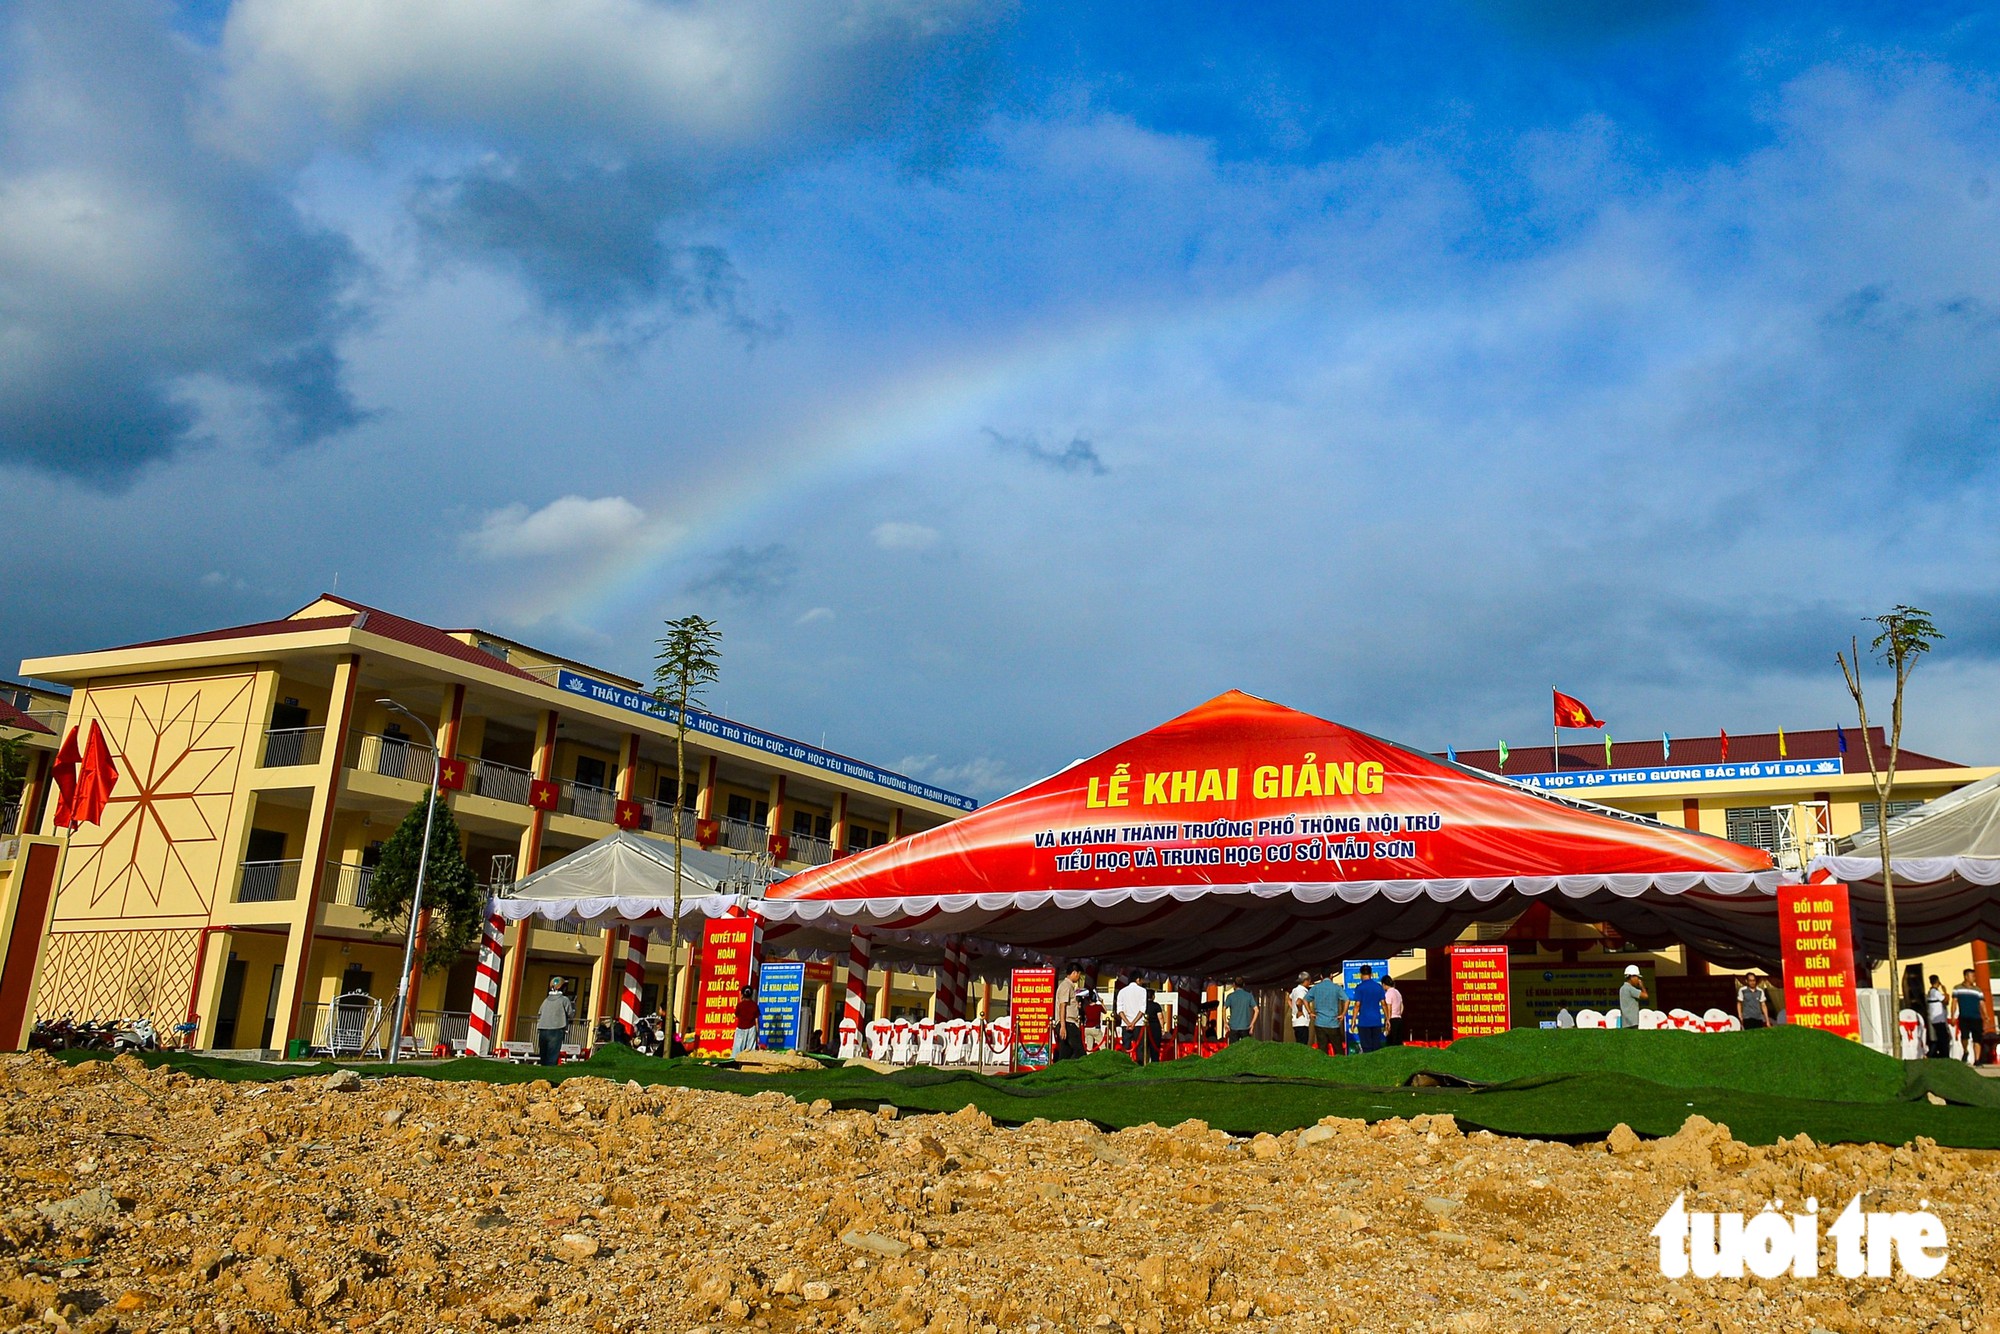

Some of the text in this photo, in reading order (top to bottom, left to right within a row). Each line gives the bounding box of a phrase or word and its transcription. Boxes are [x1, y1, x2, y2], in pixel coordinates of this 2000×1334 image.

[624, 696, 639, 708] CÔ
[698, 719, 719, 733] HỌC
[743, 731, 763, 747] TÍCH
[807, 752, 825, 765] HỌC
[826, 758, 841, 770] YÊU
[878, 773, 907, 790] TRƯỜNG
[908, 783, 922, 795] HỌC
[923, 788, 942, 799] HẠNH
[943, 794, 961, 806] PHÚC
[1086, 752, 1384, 808] LỄ KHAI GIẢNG
[1545, 776, 1574, 787] HỌC
[1577, 774, 1605, 785] TẬP
[1610, 772, 1647, 782] THEO
[1650, 769, 1701, 781] GƯƠNG
[1705, 766, 1736, 778] BÁC
[1765, 764, 1780, 775] VĨ
[1784, 764, 1811, 775] ĐẠI
[1035, 812, 1441, 848] VÀ KHÁNH THÀNH TRƯỜNG PHỔ THÔNG NỘI TRÚ
[1055, 837, 1416, 872] TIỂU HỌC VÀ TRUNG HỌC CƠ SỞ MẪU SƠN
[1793, 897, 1833, 913] ĐỔI MỚI
[1797, 919, 1832, 932] TƯ DUY
[710, 930, 746, 944] QUYẾT TÂM
[1796, 934, 1837, 950] CHUYỂN
[717, 947, 736, 959] HOÀN
[1805, 954, 1830, 969] BIẾN
[707, 978, 725, 991] XUẤT
[1794, 976, 1826, 990] MẠNH
[706, 995, 738, 1009] NHIỆM VỤ
[1800, 991, 1843, 1008] KẾT QUẢ
[705, 1012, 736, 1025] NĂM HỌC
[1794, 1009, 1850, 1028] THỰC CHẤT
[721, 1030, 736, 1040] 202
